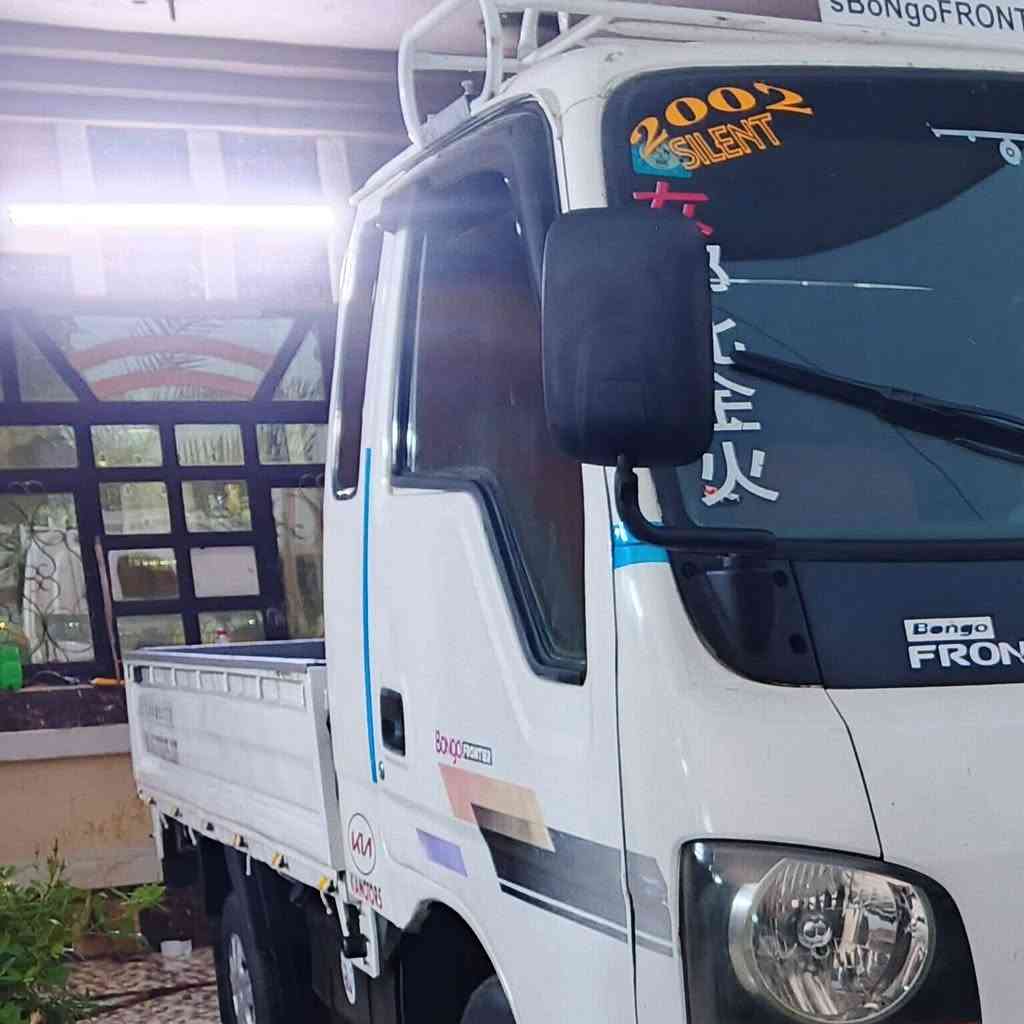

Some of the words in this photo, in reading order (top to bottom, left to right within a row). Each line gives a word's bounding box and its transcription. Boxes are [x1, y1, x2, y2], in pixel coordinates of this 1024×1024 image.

[630, 80, 815, 160] 2002
[668, 112, 783, 171] SILENT
[912, 622, 988, 637] Bongo
